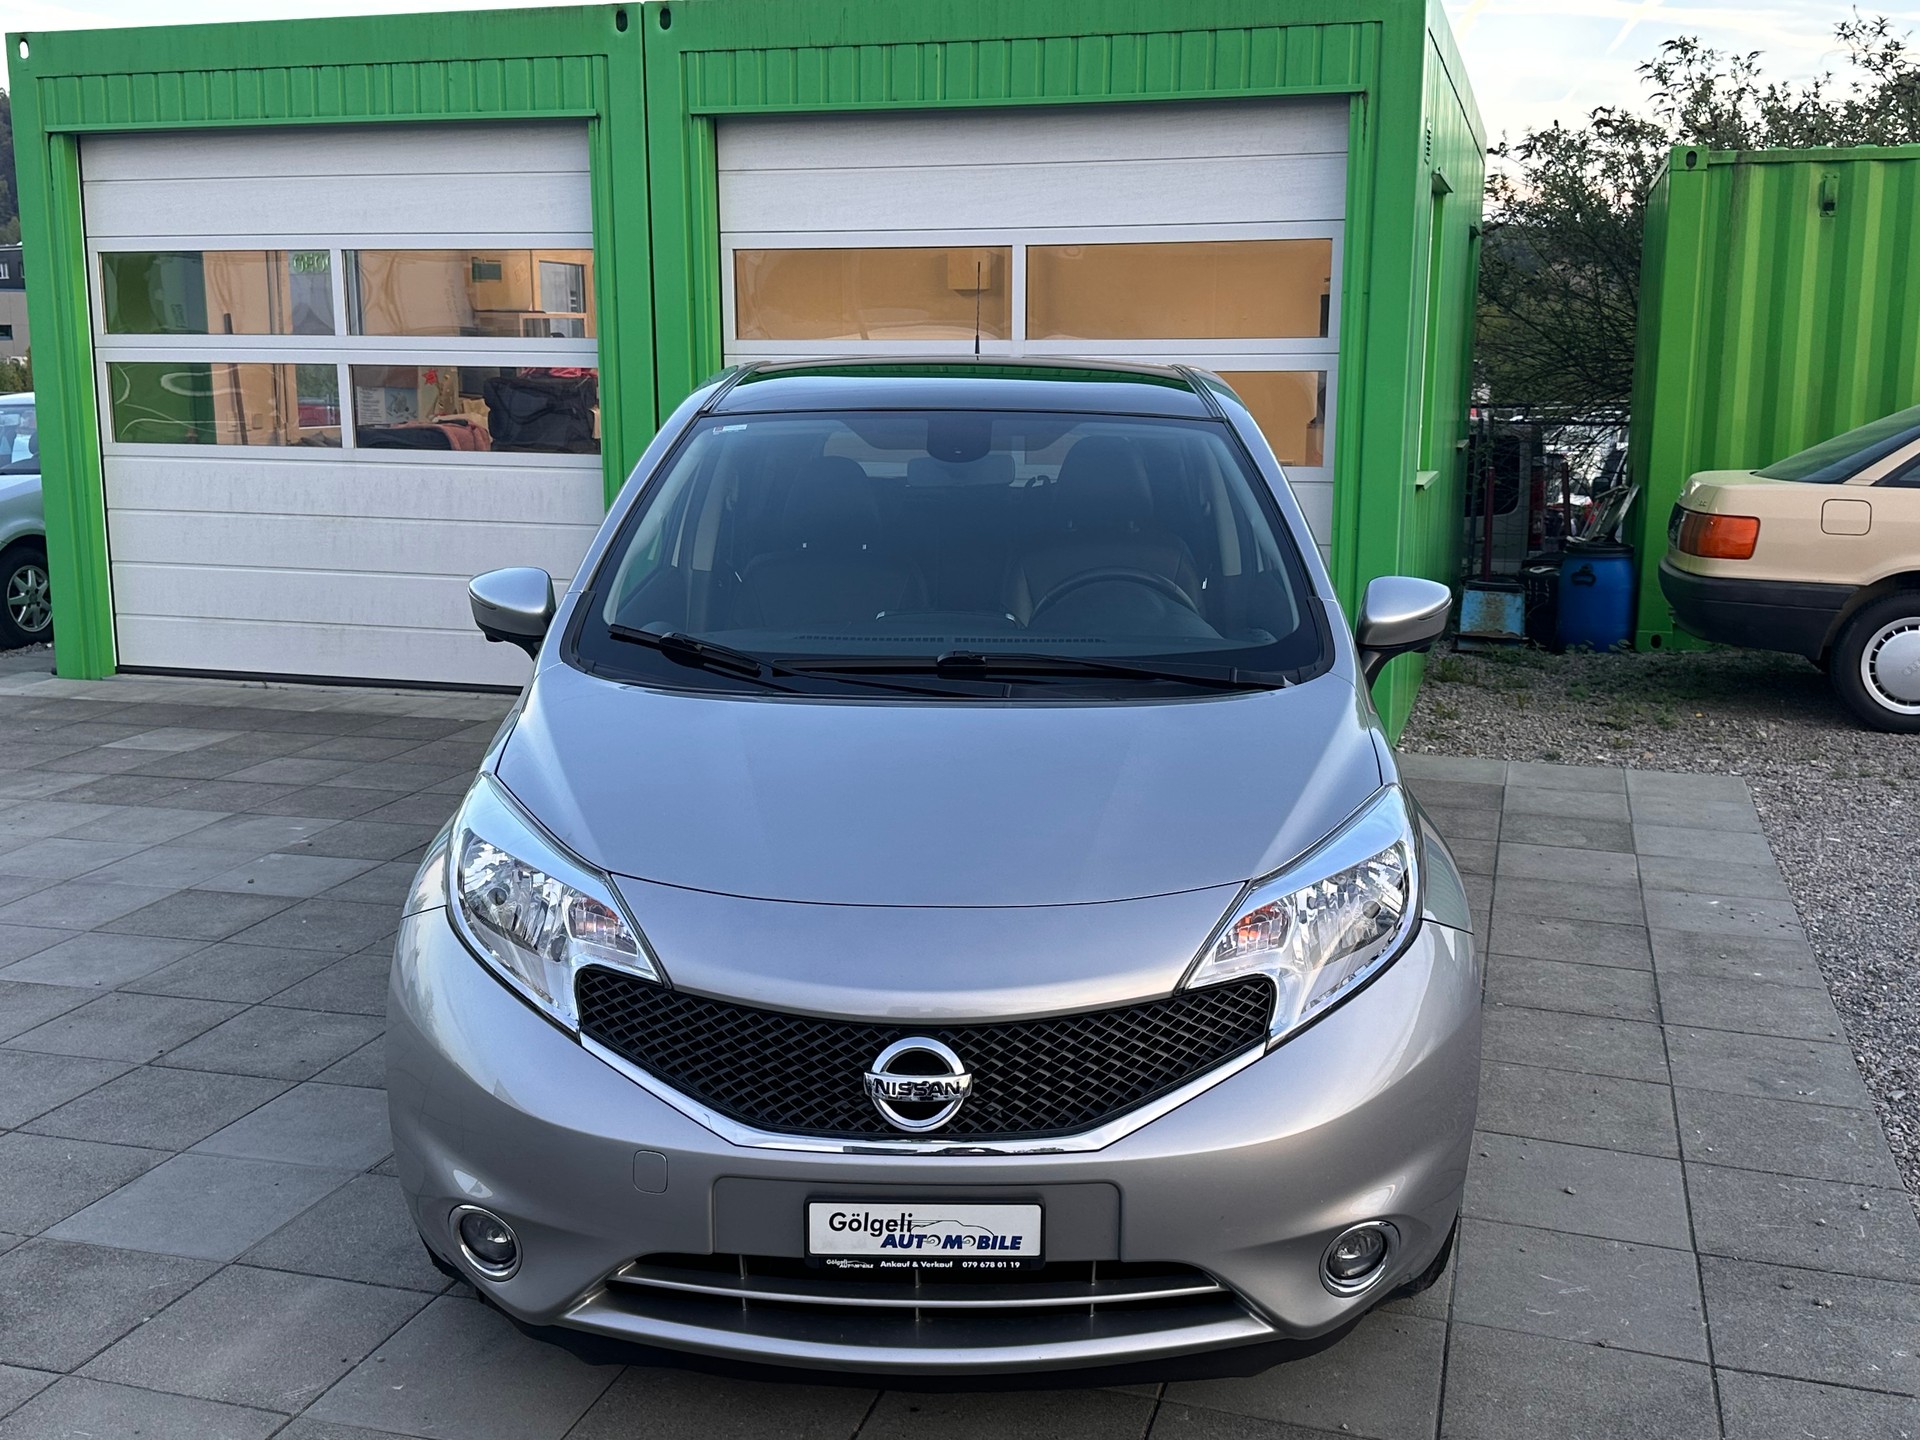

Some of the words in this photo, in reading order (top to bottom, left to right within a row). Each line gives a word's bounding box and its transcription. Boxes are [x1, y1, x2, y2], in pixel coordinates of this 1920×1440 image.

[873, 1079, 960, 1097] NISSAN
[829, 1212, 913, 1237] Gölgeli
[880, 1234, 1022, 1250] AUTOMOBILE
